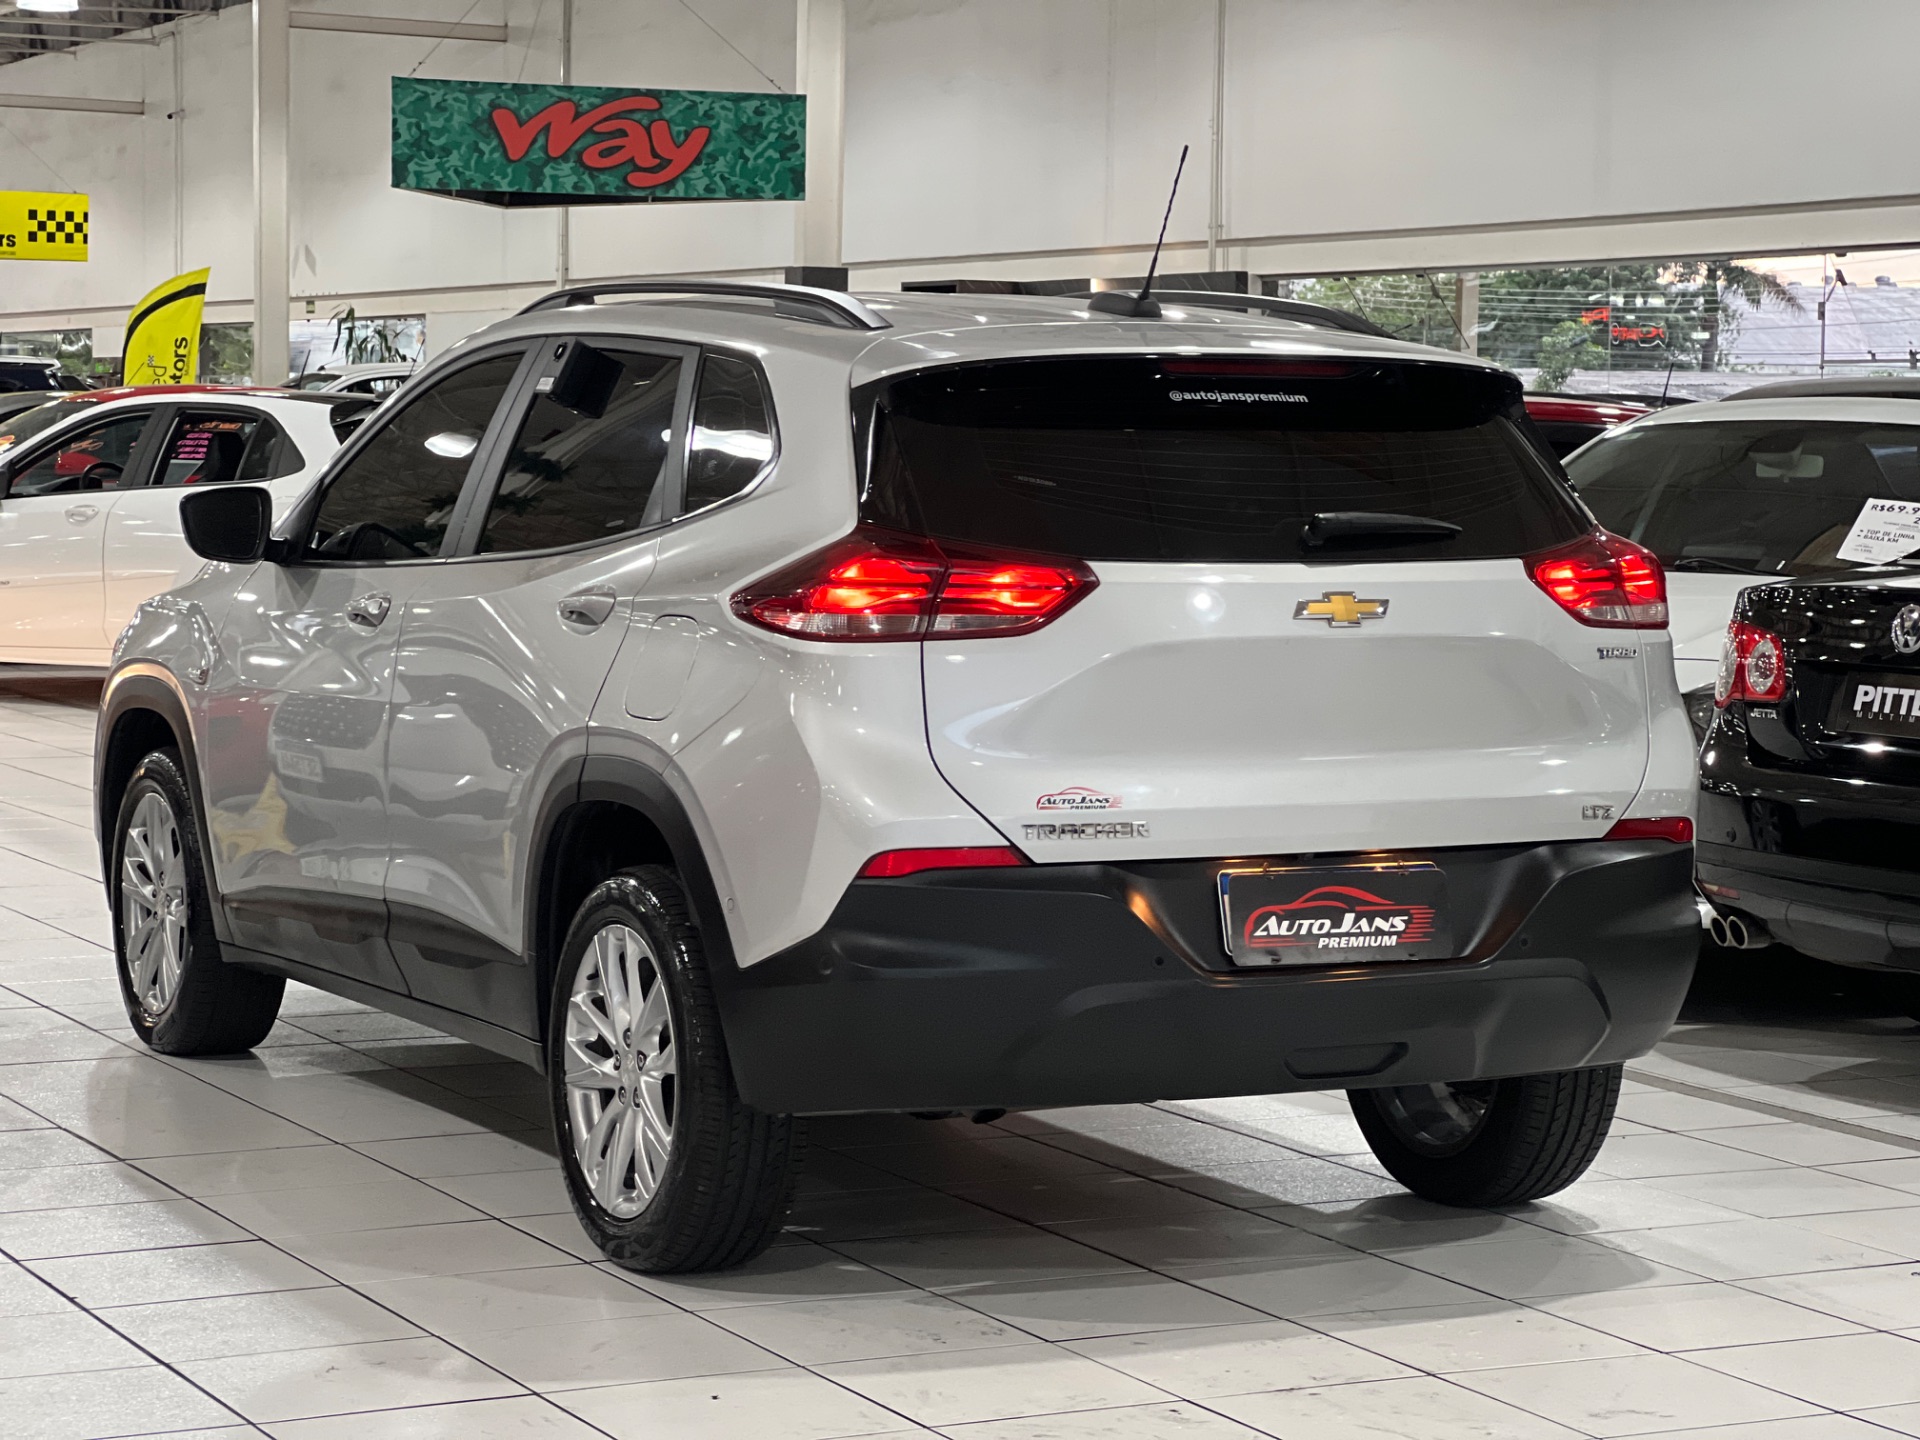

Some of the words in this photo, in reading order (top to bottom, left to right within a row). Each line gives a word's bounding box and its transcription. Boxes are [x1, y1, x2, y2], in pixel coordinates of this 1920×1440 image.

[491, 96, 710, 188] Way
[1169, 390, 1309, 403] @autojanspremium
[1863, 534, 1885, 542] BAIXA
[1893, 532, 1915, 540] LINHA
[1750, 708, 1777, 719] JETTA
[1021, 821, 1150, 840] TRACKER
[1318, 935, 1397, 948] PREMIUM
